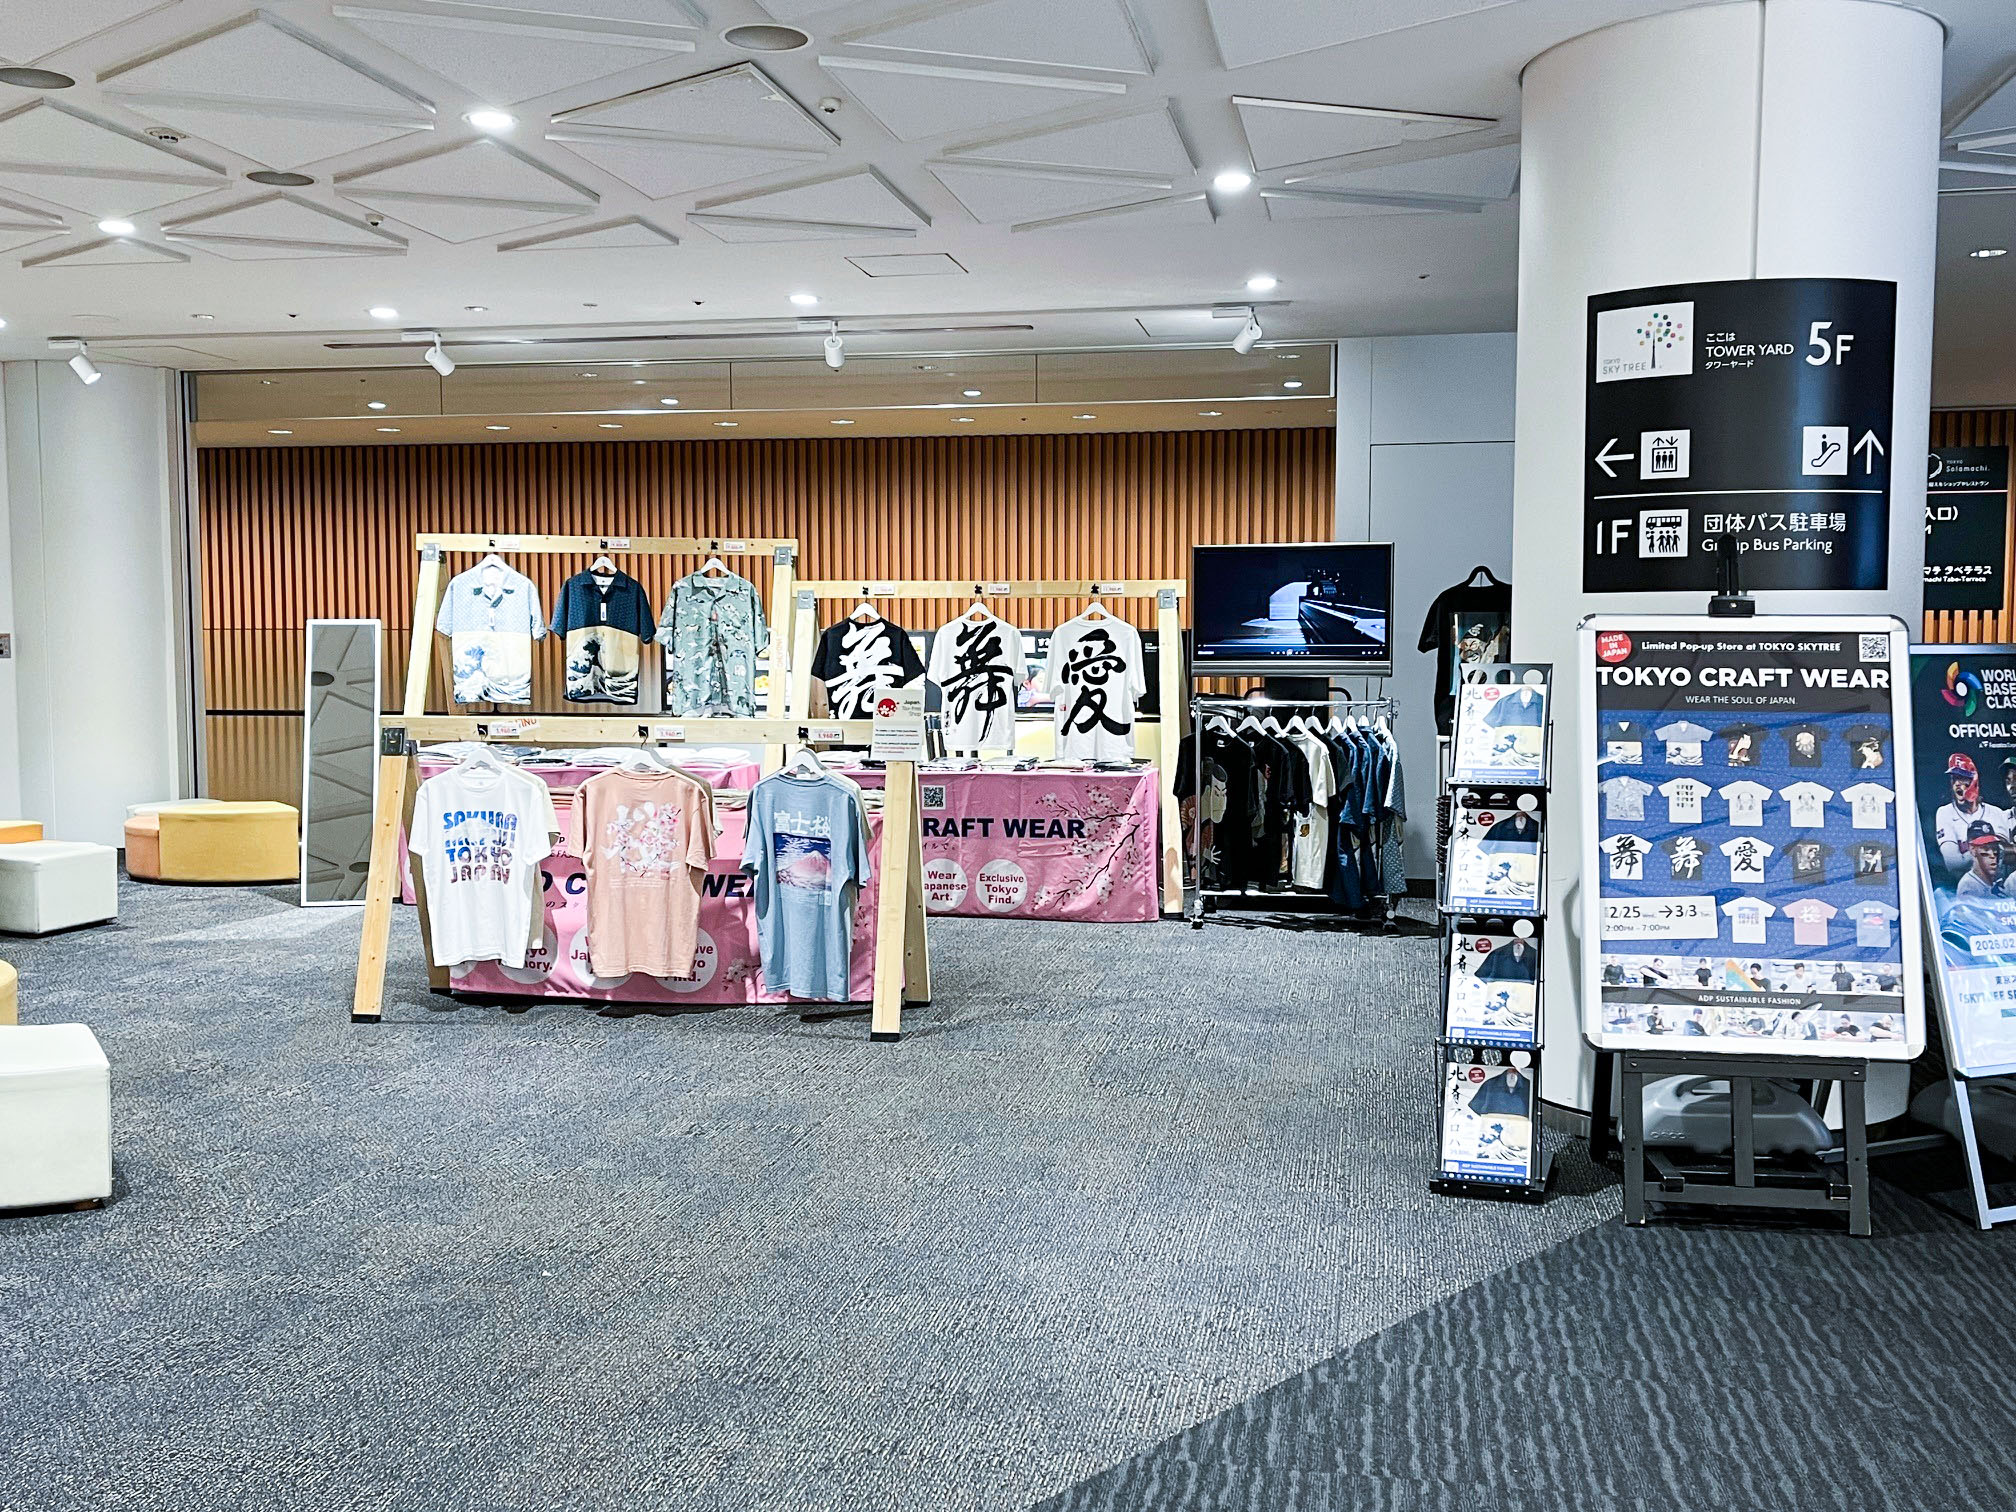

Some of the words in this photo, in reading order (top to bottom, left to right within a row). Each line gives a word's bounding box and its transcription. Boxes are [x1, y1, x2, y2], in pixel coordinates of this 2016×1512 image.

[1706, 332, 1736, 342] ここは
[1805, 321, 1854, 366] 5F
[1705, 344, 1756, 358] TOWER
[1758, 343, 1795, 356] YARD
[1602, 364, 1621, 375] SKY
[1623, 362, 1647, 373] TREE
[1705, 360, 1754, 370] タワーヤード
[1703, 512, 1847, 533] 団体バス駐車場
[1701, 538, 1750, 555] Grp
[1753, 538, 1780, 551] Bus
[1783, 538, 1833, 555] Parking
[1600, 633, 1624, 644] MADE
[1602, 647, 1628, 658] JAPAN
[1641, 641, 1678, 650] Limited
[1680, 641, 1715, 652] Pop-up
[1716, 642, 1743, 651] Store
[1745, 642, 1756, 651] at
[1758, 642, 1795, 651] TOKYO
[1797, 642, 1841, 651] SKYTREE
[1060, 628, 1131, 736] 愛
[1596, 666, 1691, 687] TOKYO
[1699, 667, 1793, 688] CRAFT
[1800, 668, 1890, 689] WEAR
[1685, 695, 1711, 704] WEAR
[1713, 696, 1729, 704] THE
[1731, 696, 1754, 704] SOUL
[1755, 696, 1768, 704] OF
[1949, 723, 2010, 739] OFFICIAL
[922, 817, 995, 838] RAFT
[1002, 818, 1087, 839] WEAR
[445, 846, 513, 867] TOKYO
[1733, 840, 1762, 872] 愛
[927, 870, 957, 880] Wear
[979, 872, 1024, 884] Exclusive
[924, 883, 967, 893] apanese
[984, 883, 1019, 895] Tokyo
[931, 892, 953, 901] Art.
[988, 894, 1015, 905] Find.
[1609, 905, 1641, 918] 2/25
[1675, 904, 1698, 918] 3/3
[1697, 994, 1714, 1003] ADP
[1715, 995, 1766, 1004] SUSTAINABLE
[1767, 997, 1802, 1006] FASHION
